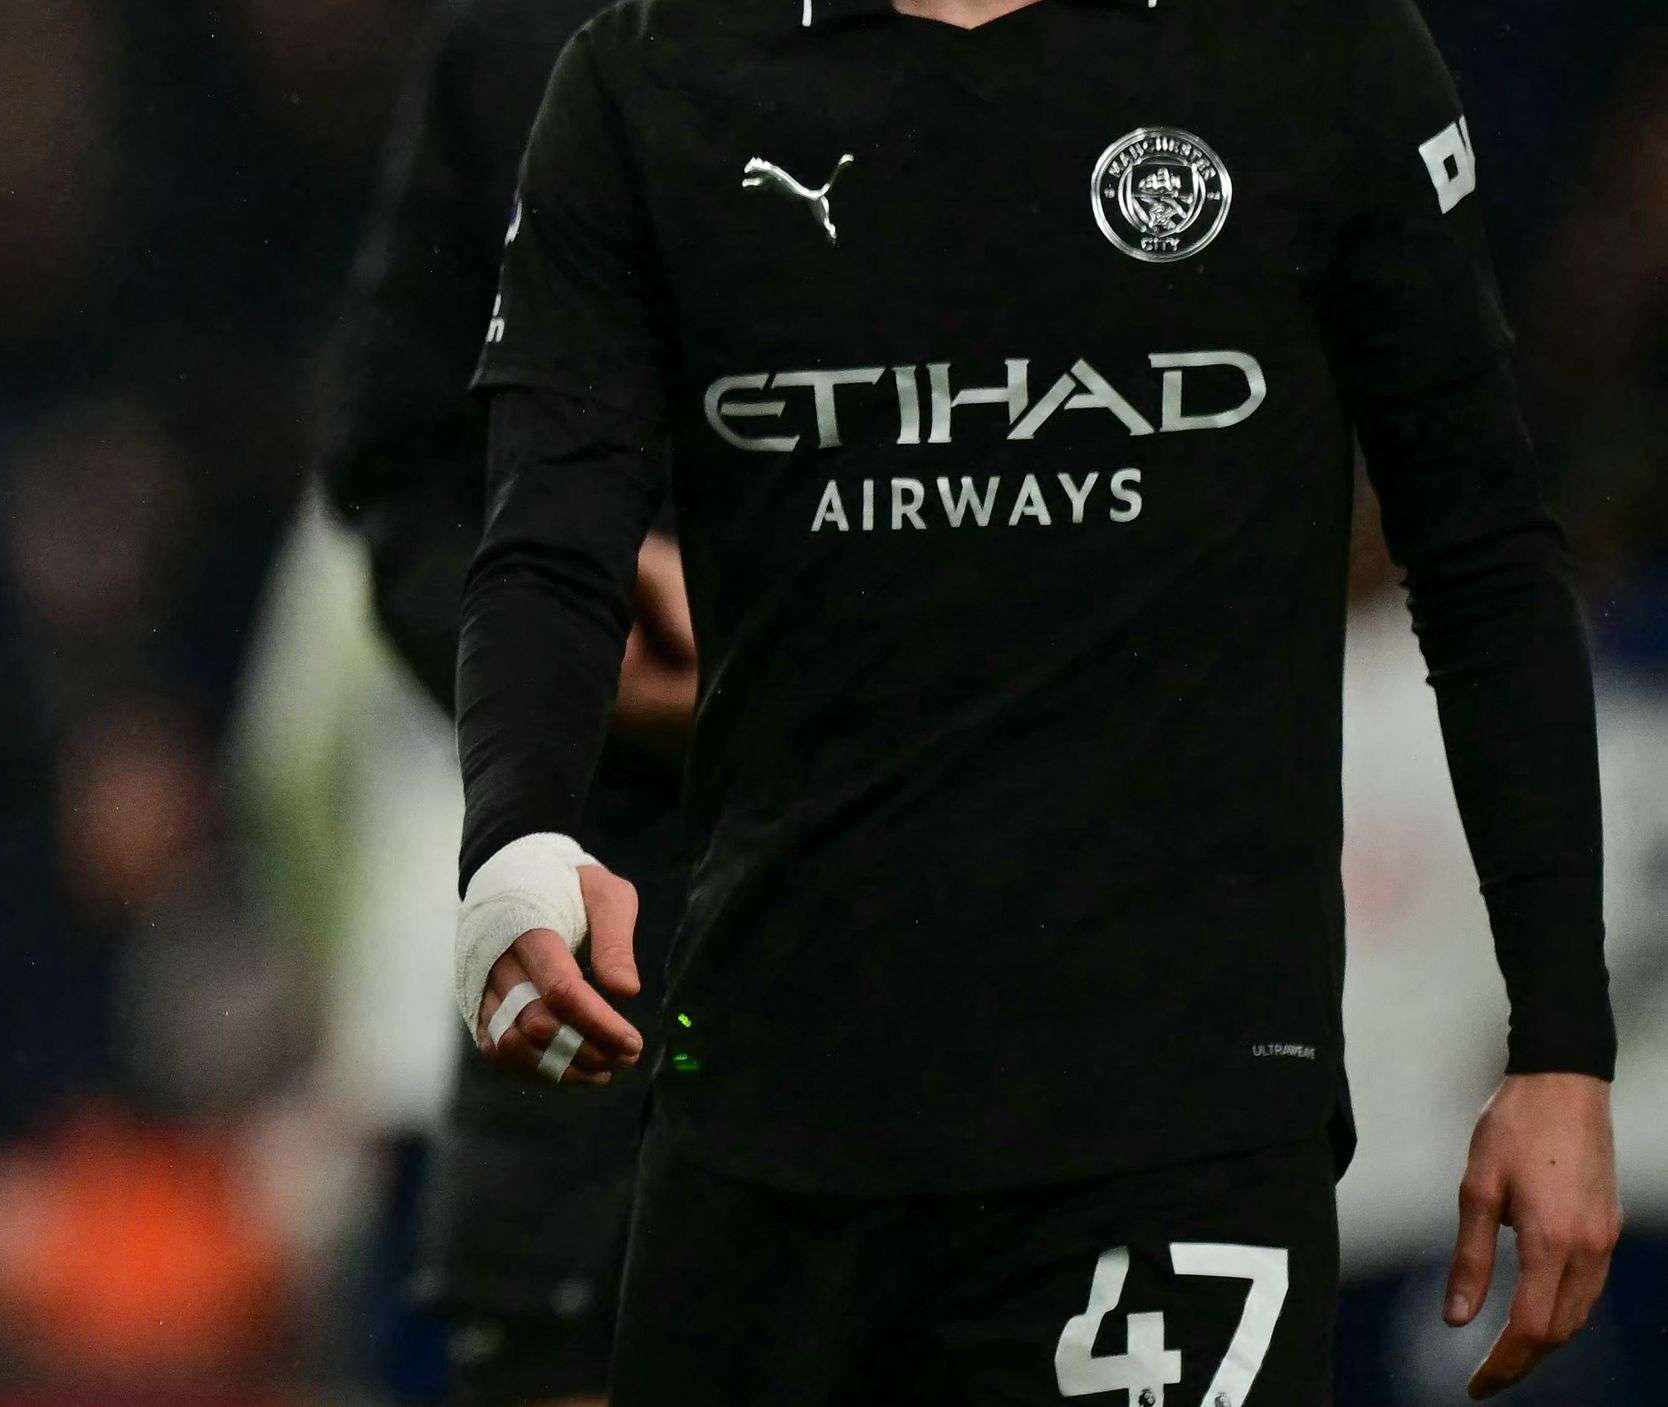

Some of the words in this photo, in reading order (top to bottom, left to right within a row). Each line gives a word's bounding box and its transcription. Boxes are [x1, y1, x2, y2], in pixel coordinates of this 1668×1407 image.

[1141, 236, 1181, 252] CITY
[703, 350, 1268, 453] ETIHAD
[810, 468, 1144, 533] AIRWAYS
[1054, 1242, 1290, 1407] 47
